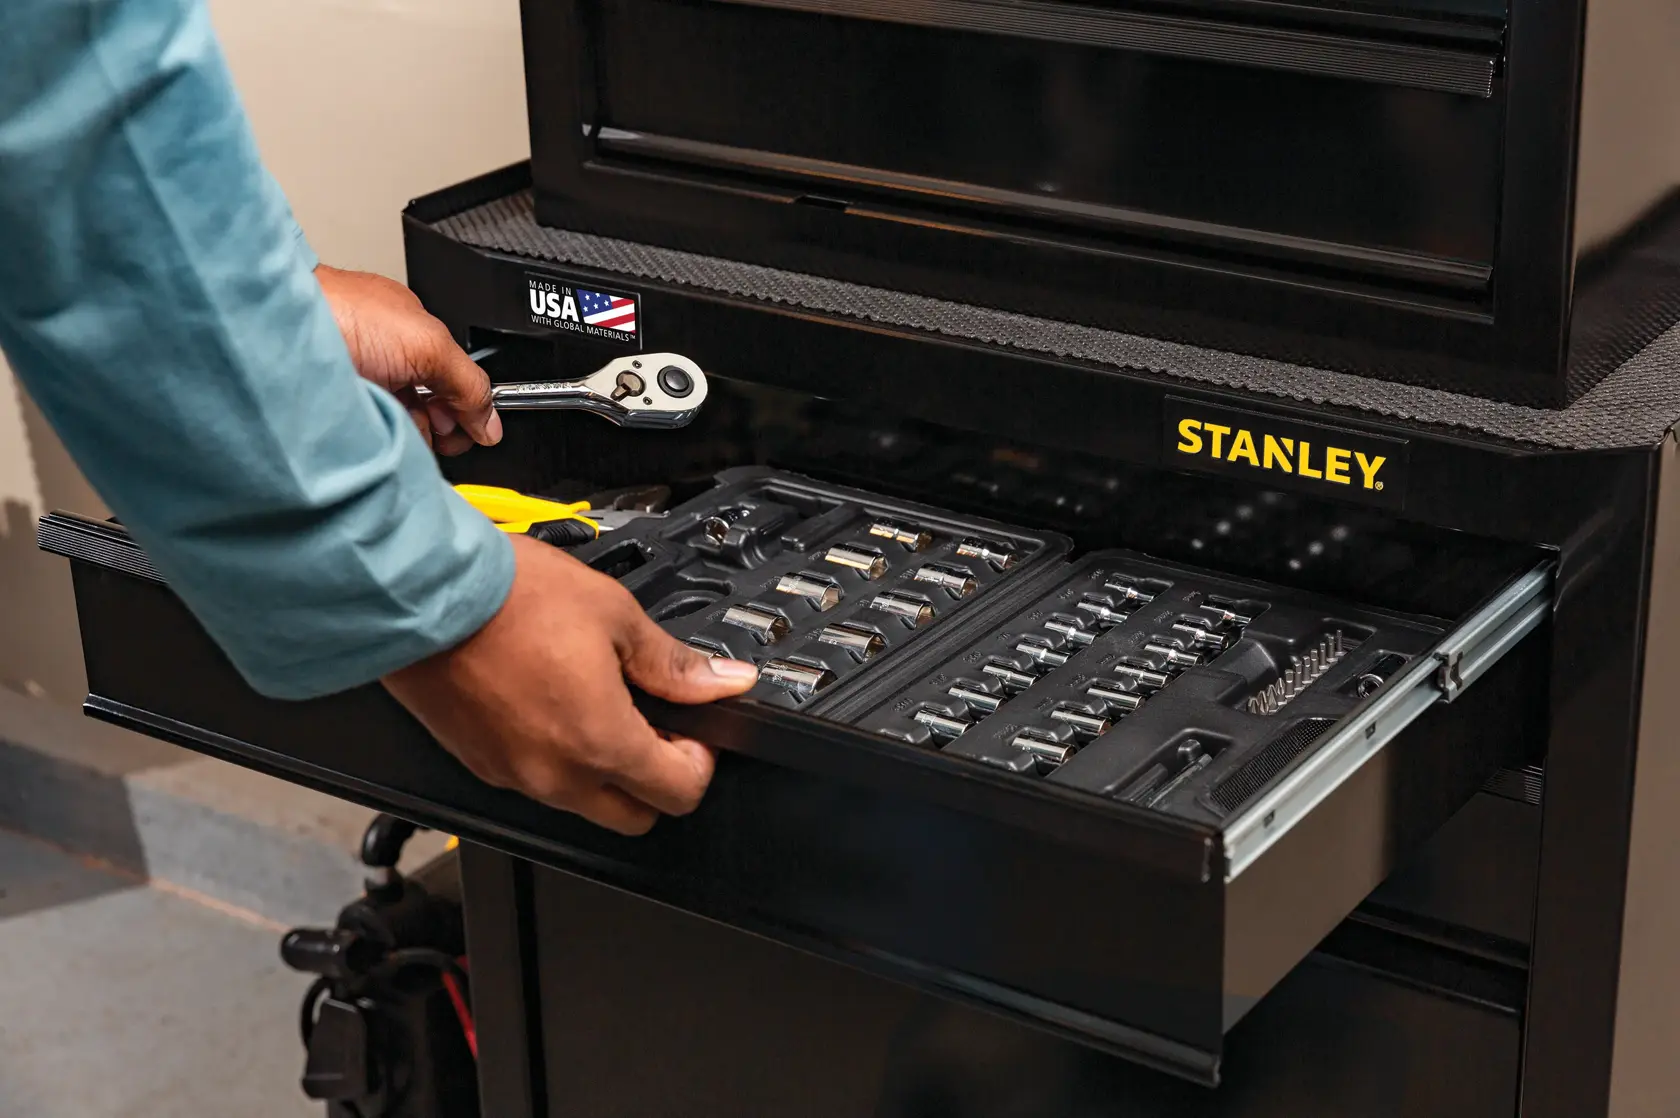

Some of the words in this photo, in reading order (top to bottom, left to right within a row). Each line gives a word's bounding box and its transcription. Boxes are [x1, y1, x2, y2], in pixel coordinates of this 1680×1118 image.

[529, 280, 557, 293] MADE
[562, 287, 572, 296] IN
[529, 289, 579, 322] USA
[531, 314, 552, 326] WITH
[553, 318, 584, 333] GLOBAL
